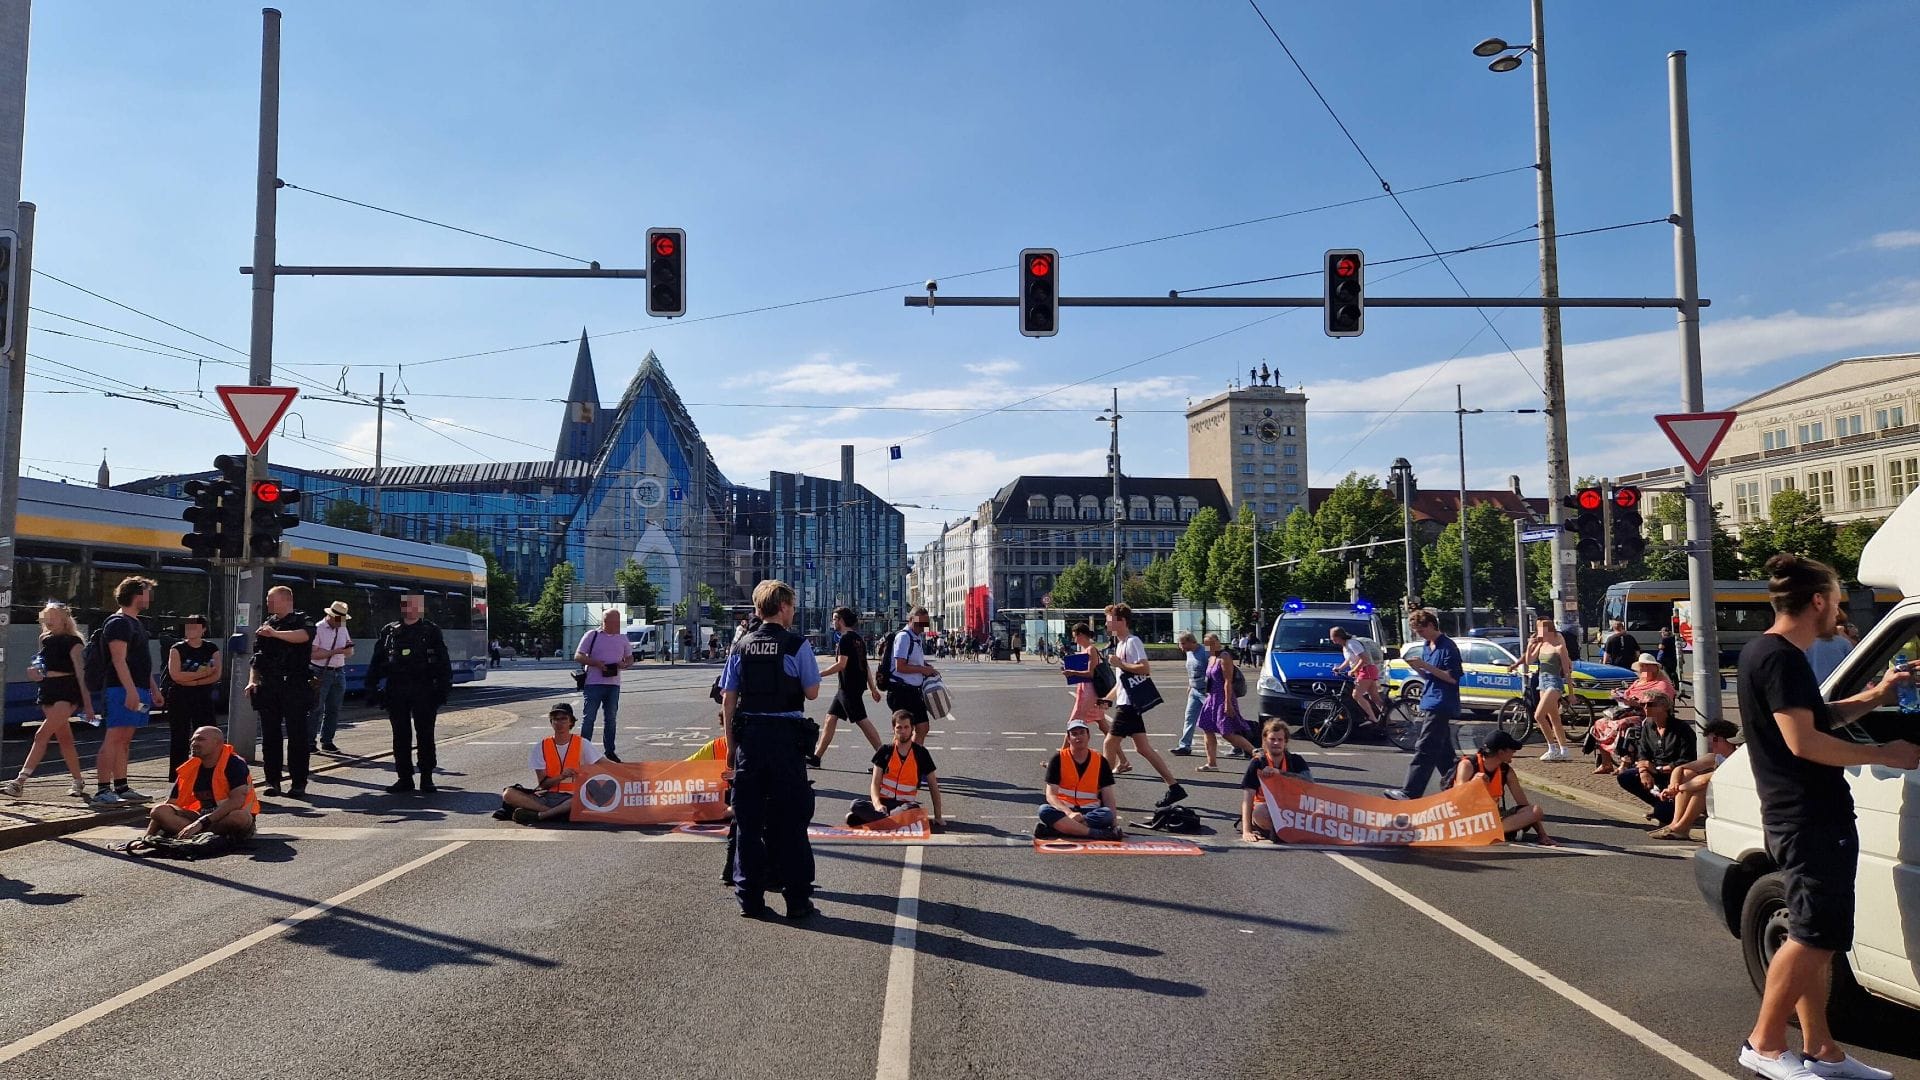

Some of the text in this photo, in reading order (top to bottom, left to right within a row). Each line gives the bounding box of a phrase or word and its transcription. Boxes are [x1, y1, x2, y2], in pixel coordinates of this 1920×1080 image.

[745, 642, 778, 655] POLIZEI
[1476, 675, 1511, 686] POLIZEI
[624, 781, 652, 794] ART.
[655, 779, 682, 793] 20A
[685, 779, 705, 791] GG
[624, 791, 720, 807] LEBEN SCHÜTZEN
[1300, 795, 1348, 820] MEHR
[1449, 811, 1497, 838] JETZT!
